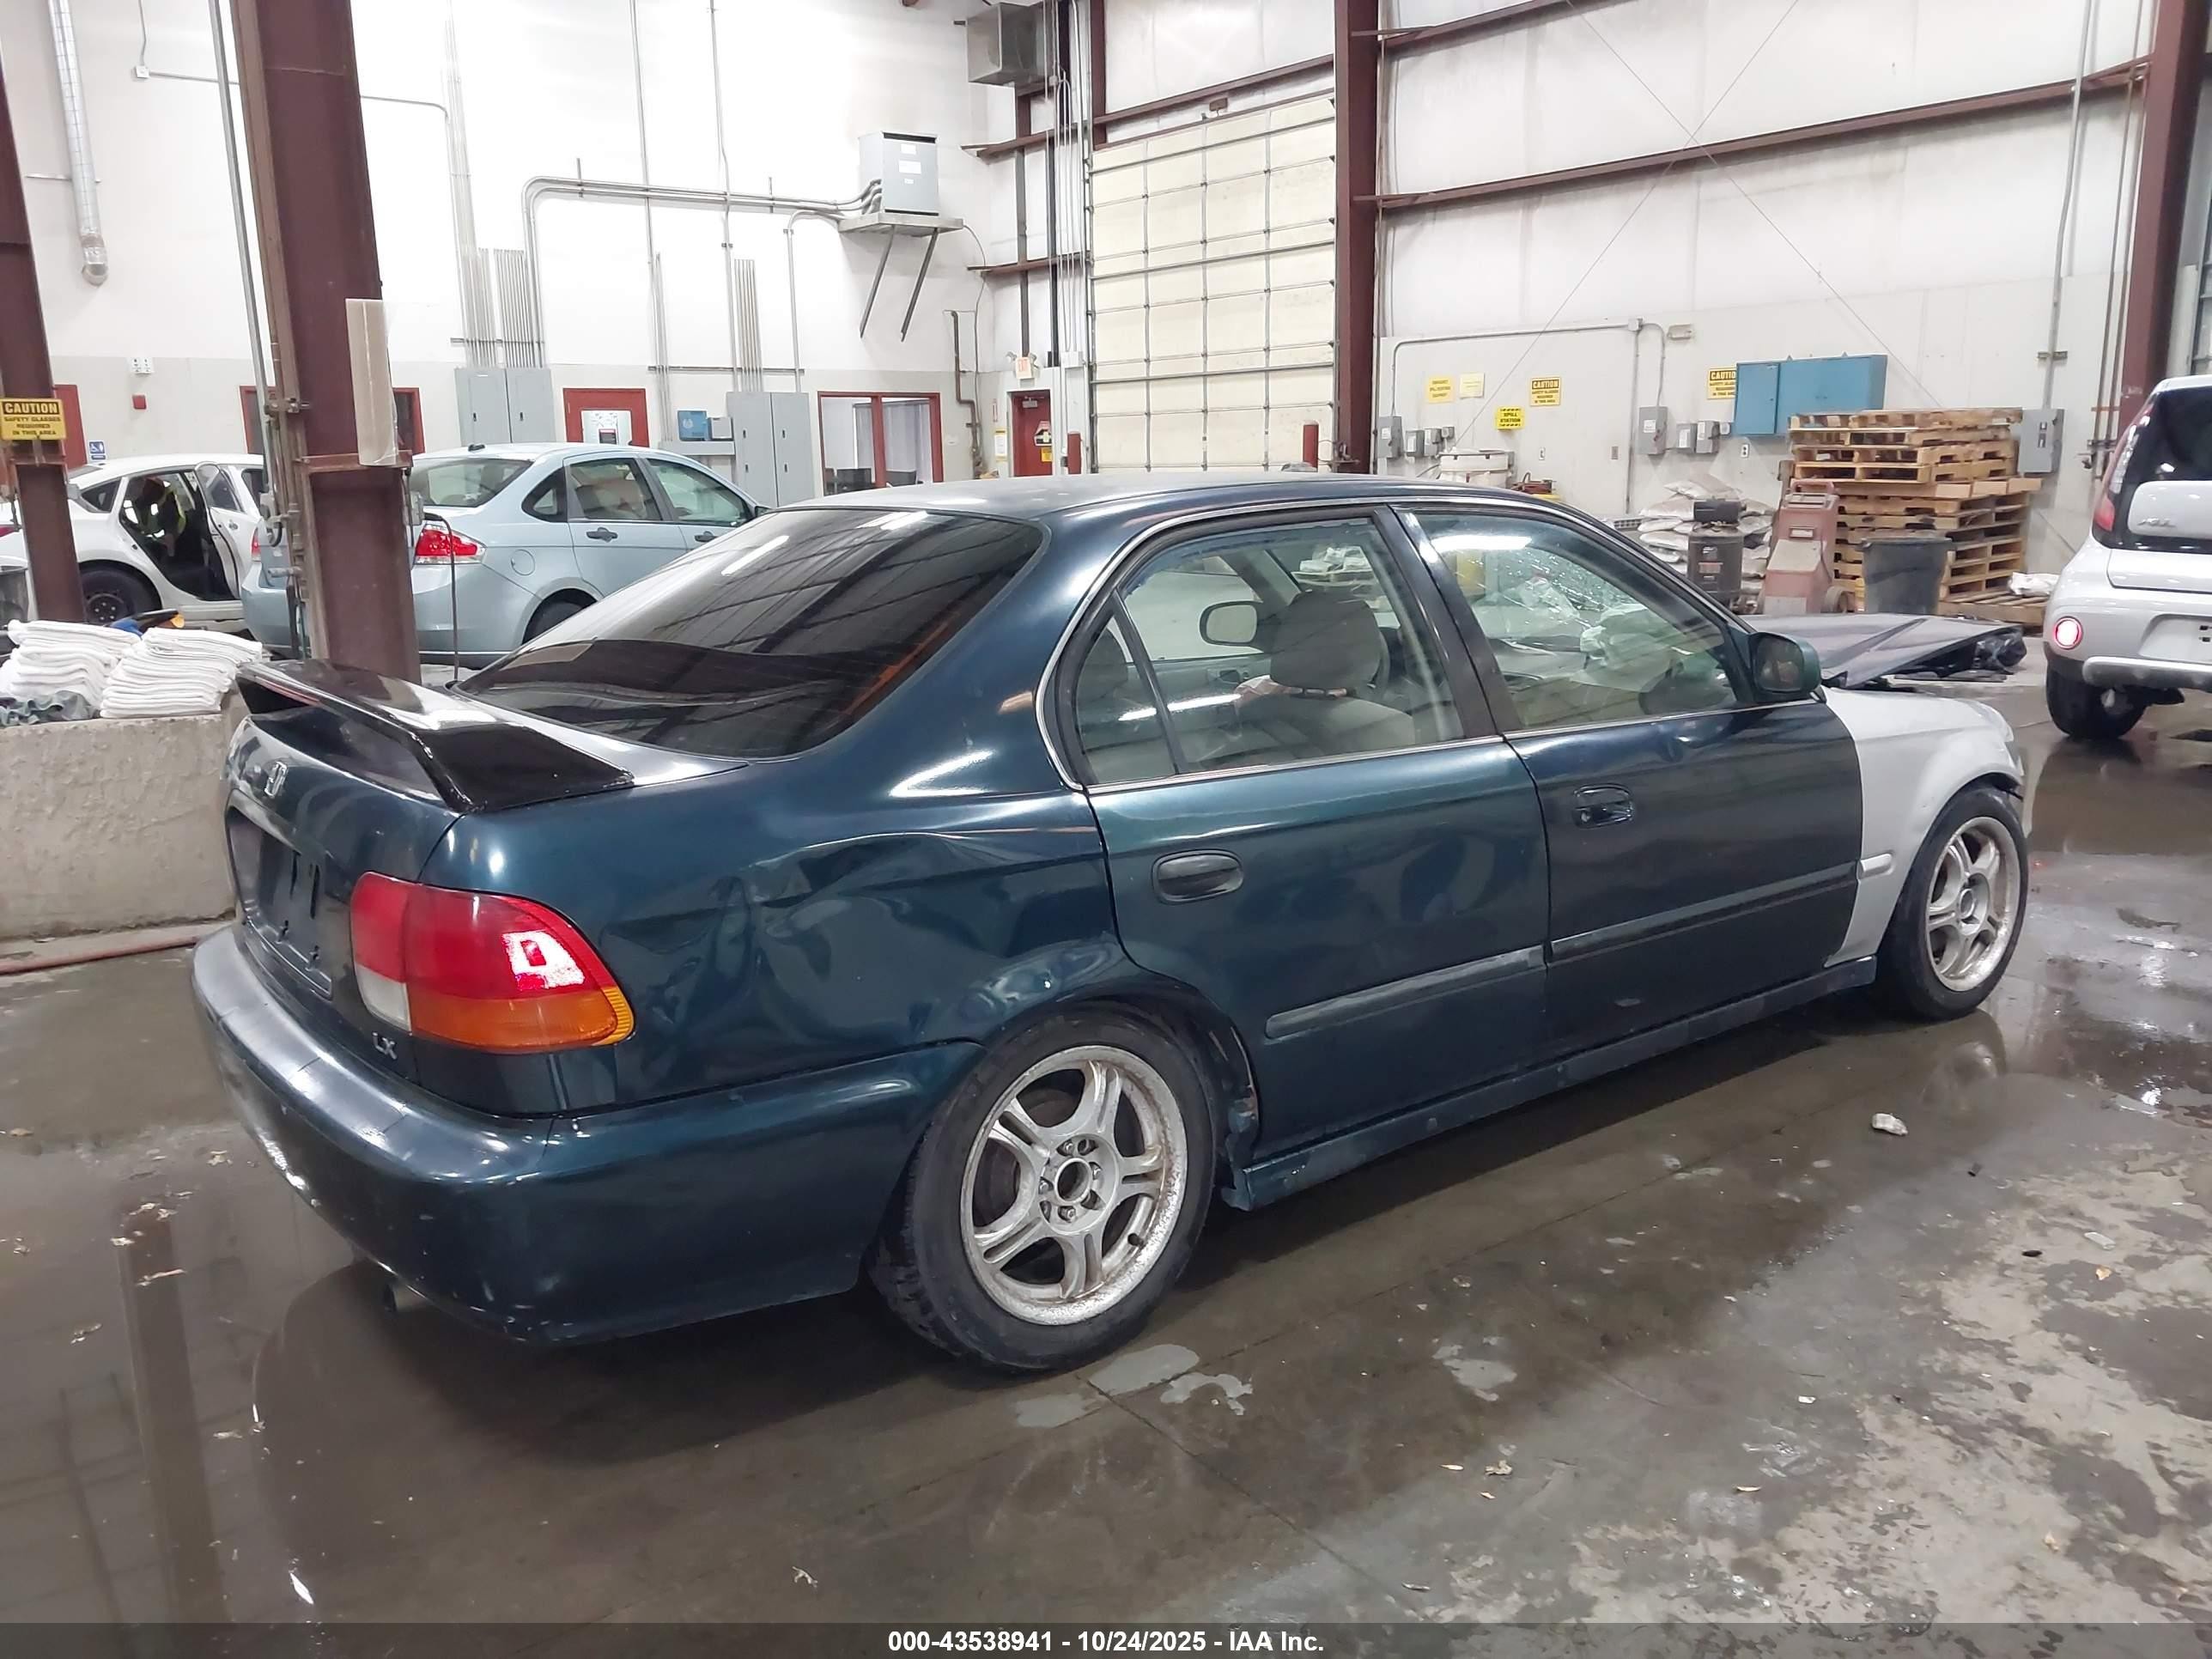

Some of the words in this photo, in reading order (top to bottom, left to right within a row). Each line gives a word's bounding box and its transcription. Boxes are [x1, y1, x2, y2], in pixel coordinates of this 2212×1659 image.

[1711, 371, 1736, 380] CAUTIO
[1532, 380, 1559, 389] CAUTION
[4, 403, 58, 414] CAUTION
